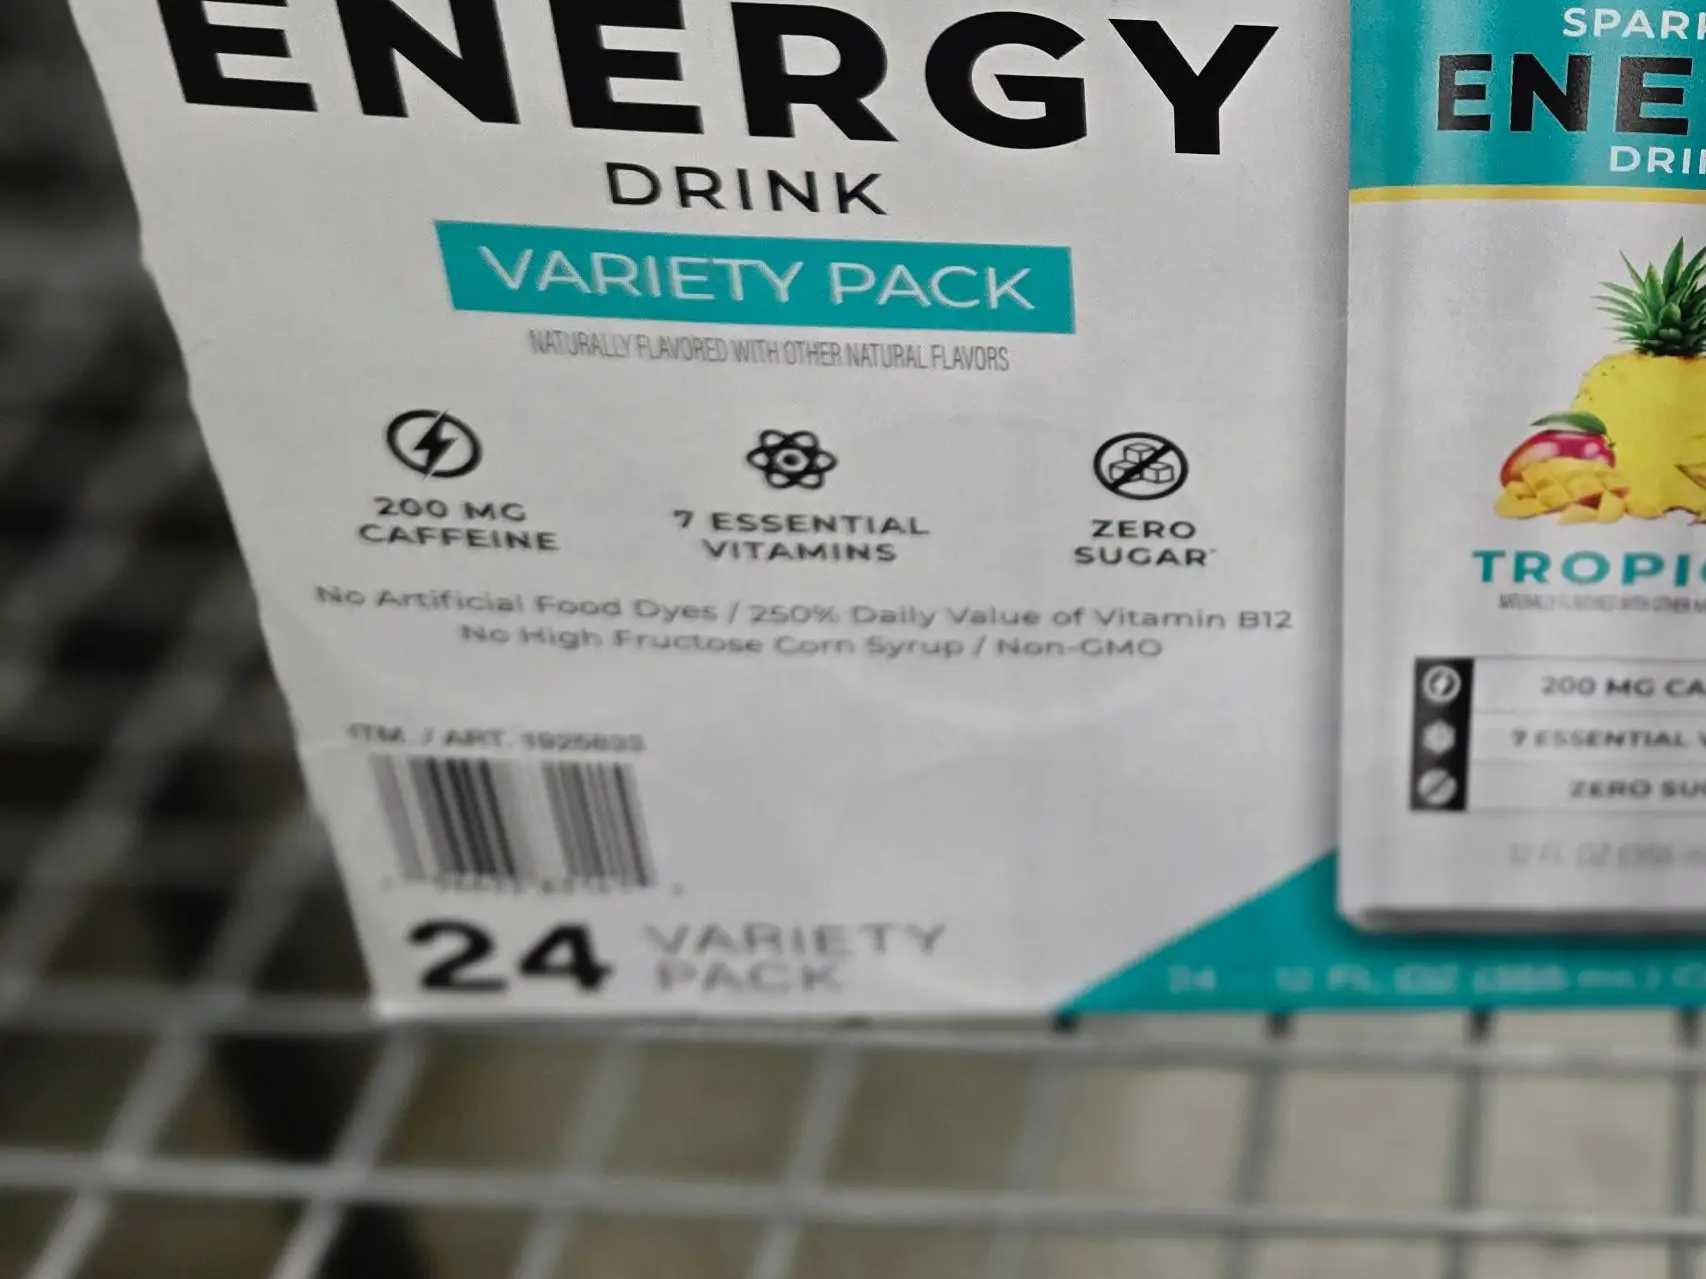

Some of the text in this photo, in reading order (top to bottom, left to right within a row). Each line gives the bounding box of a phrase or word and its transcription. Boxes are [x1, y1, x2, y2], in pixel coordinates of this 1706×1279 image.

[605, 161, 888, 215] DRINK
[477, 244, 1036, 311] VARIETY PACK
[529, 329, 1010, 373] NATURALLY FLAVORED WITH OTHER NATURAL FLAVORS
[373, 496, 527, 522] 200 MG
[673, 510, 931, 536] 7 ESSENTIAL
[358, 524, 561, 552] CAFFEINE
[1091, 519, 1197, 540] ZERO
[699, 539, 898, 563] VITAMINS
[315, 585, 1294, 630] No Artificial Food Dyes / 250% Daily Value of Vitamin B12
[460, 624, 510, 644] No
[519, 626, 603, 650] High
[615, 629, 764, 653] Fructose
[773, 634, 856, 656] Corn
[865, 636, 965, 661] Syrup
[994, 637, 1164, 659] Non-GMO
[1541, 676, 1596, 695] 200
[1605, 677, 1654, 697] MG
[1534, 729, 1689, 749] ESSENTIAL
[1570, 779, 1652, 799] ZERO
[407, 919, 949, 993] 24 VARIETY
[655, 961, 846, 994] PACK
